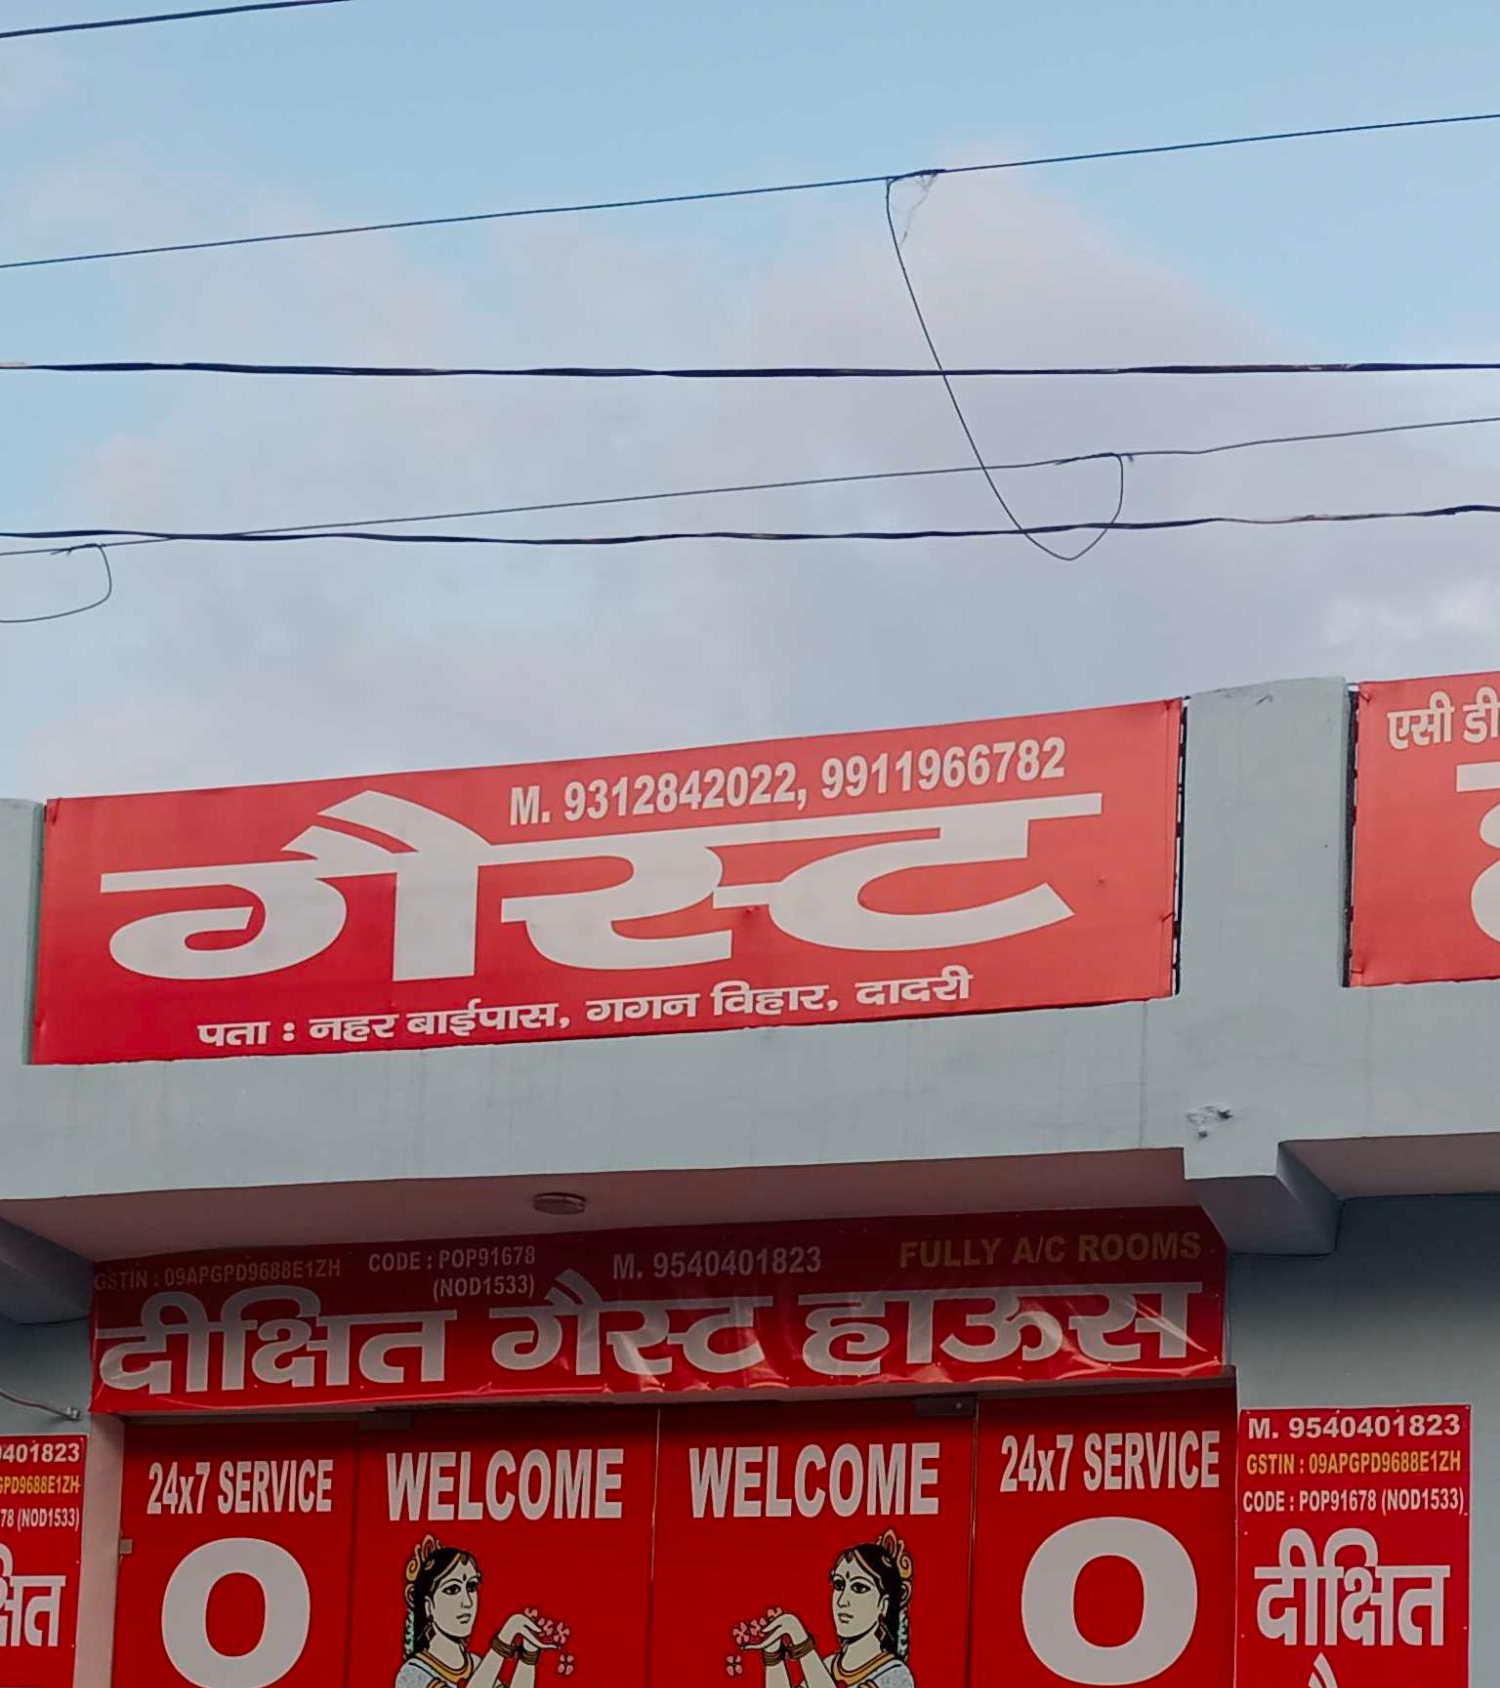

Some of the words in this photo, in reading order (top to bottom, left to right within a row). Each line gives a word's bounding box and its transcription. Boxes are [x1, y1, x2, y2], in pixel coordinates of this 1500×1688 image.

[1387, 691, 1455, 750] एसी
[510, 786, 550, 825] M.
[565, 762, 807, 821] 9312842022,
[822, 737, 1065, 798] 9911966782
[101, 790, 1100, 981] गैस्ट
[197, 1021, 270, 1047] पता
[308, 1014, 399, 1042] नहर
[406, 998, 570, 1039] बाईपास,
[586, 993, 701, 1022] गगन
[711, 980, 838, 1015] विहार,
[855, 965, 973, 1004] दादरी
[369, 1251, 421, 1273] CODE
[439, 1245, 536, 1271] POP91678
[613, 1252, 642, 1279] M.
[653, 1245, 822, 1280] 9540401823
[900, 1238, 1002, 1270] FULLY
[1013, 1235, 1066, 1266] A/C
[1078, 1231, 1202, 1264] ROOMS
[93, 1270, 148, 1291] GSTIN
[95, 1285, 458, 1396] दीक्षित
[489, 1269, 773, 1375] गैस्ट
[799, 1282, 1202, 1377] हाऊस
[1248, 1417, 1279, 1440] M.
[1288, 1413, 1461, 1439] 9540401823
[147, 1462, 211, 1515] 24x7
[217, 1458, 334, 1514] SERVICE
[386, 1448, 625, 1522] WELCOME
[688, 1441, 941, 1520] WELCOME
[1000, 1433, 1075, 1493] 24x7
[1082, 1430, 1221, 1491] SERVICE
[1246, 1453, 1296, 1476] GSTIN
[1309, 1450, 1461, 1474] 09APGPD9688E1ZH
[17, 1507, 80, 1531] (NOD1533)
[1242, 1490, 1285, 1513] CODE
[1299, 1489, 1376, 1512] POP91678
[1381, 1487, 1464, 1516] (NOD1533)
[1254, 1527, 1451, 1647] दीक्षित
